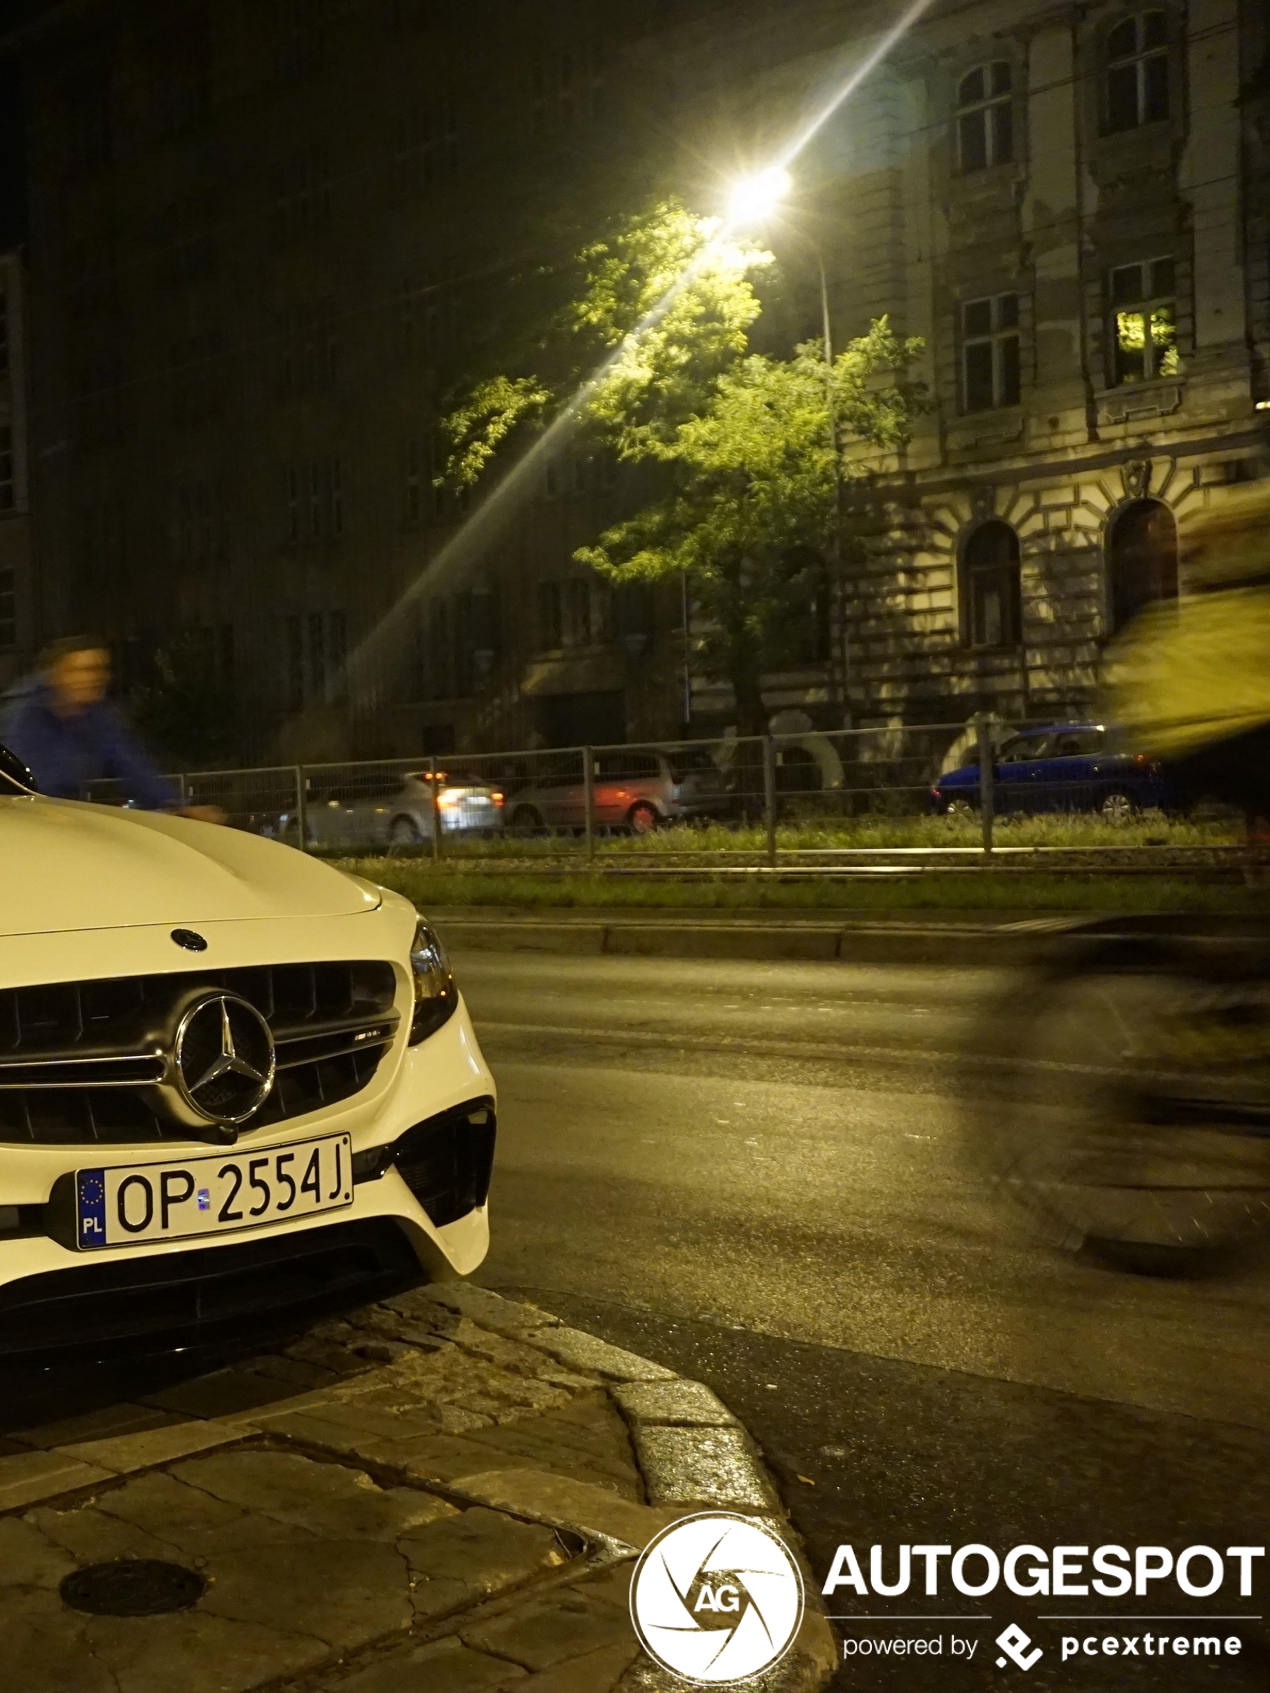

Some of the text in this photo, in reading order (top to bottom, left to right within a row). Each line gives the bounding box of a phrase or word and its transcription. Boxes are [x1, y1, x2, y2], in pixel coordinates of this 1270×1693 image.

[117, 1143, 341, 1233] OP 2554J
[83, 1217, 102, 1234] PL
